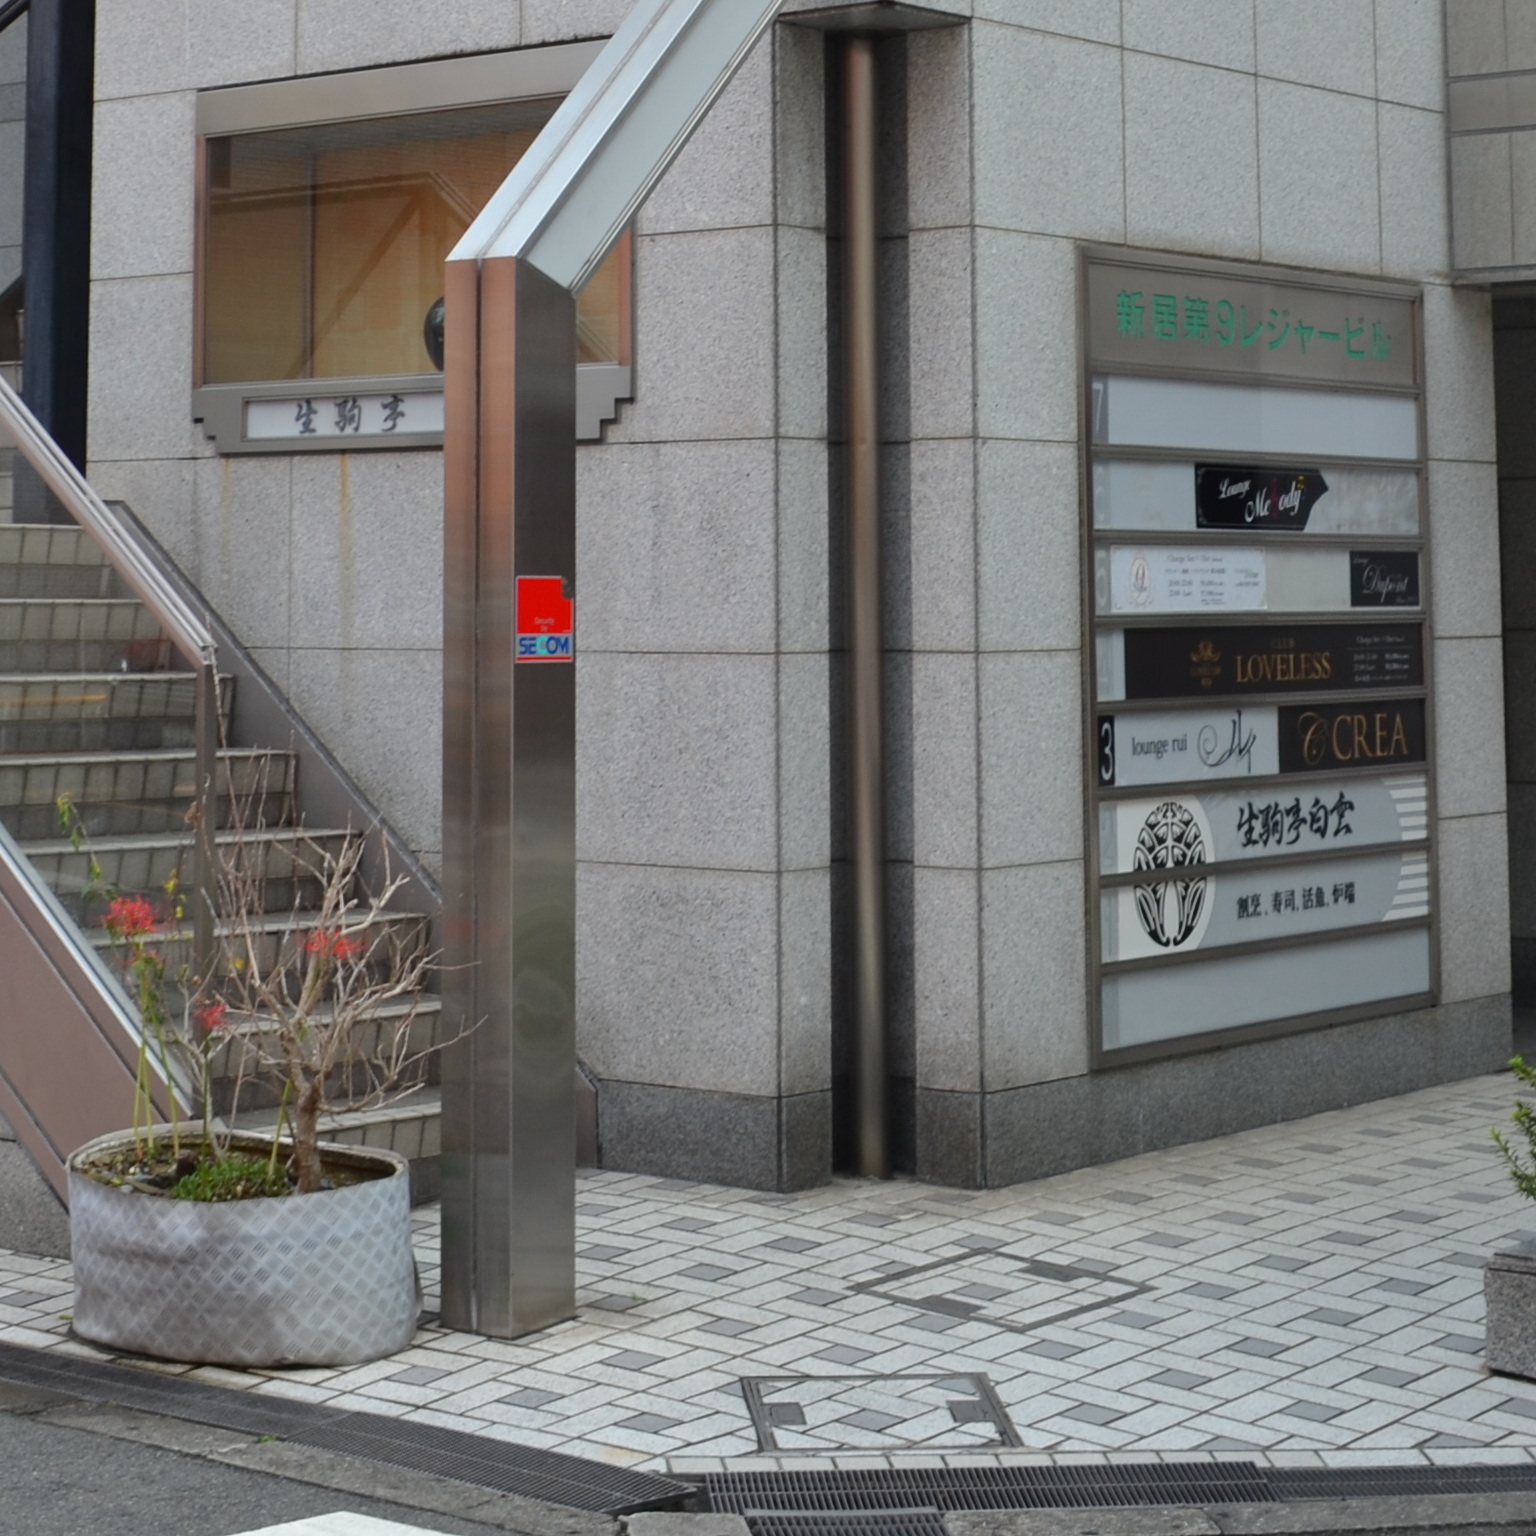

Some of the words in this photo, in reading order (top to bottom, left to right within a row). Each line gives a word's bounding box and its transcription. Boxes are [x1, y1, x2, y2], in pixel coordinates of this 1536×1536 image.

[1116, 289, 1393, 360] 新居第9レジャービル
[294, 394, 406, 434] 生駒亭
[519, 635, 570, 656] SECOM
[1235, 652, 1332, 683] LOVELESS
[1100, 721, 1113, 782] 3
[1131, 736, 1169, 759] lounge
[1171, 733, 1187, 752] rui
[1332, 712, 1409, 761] CREA
